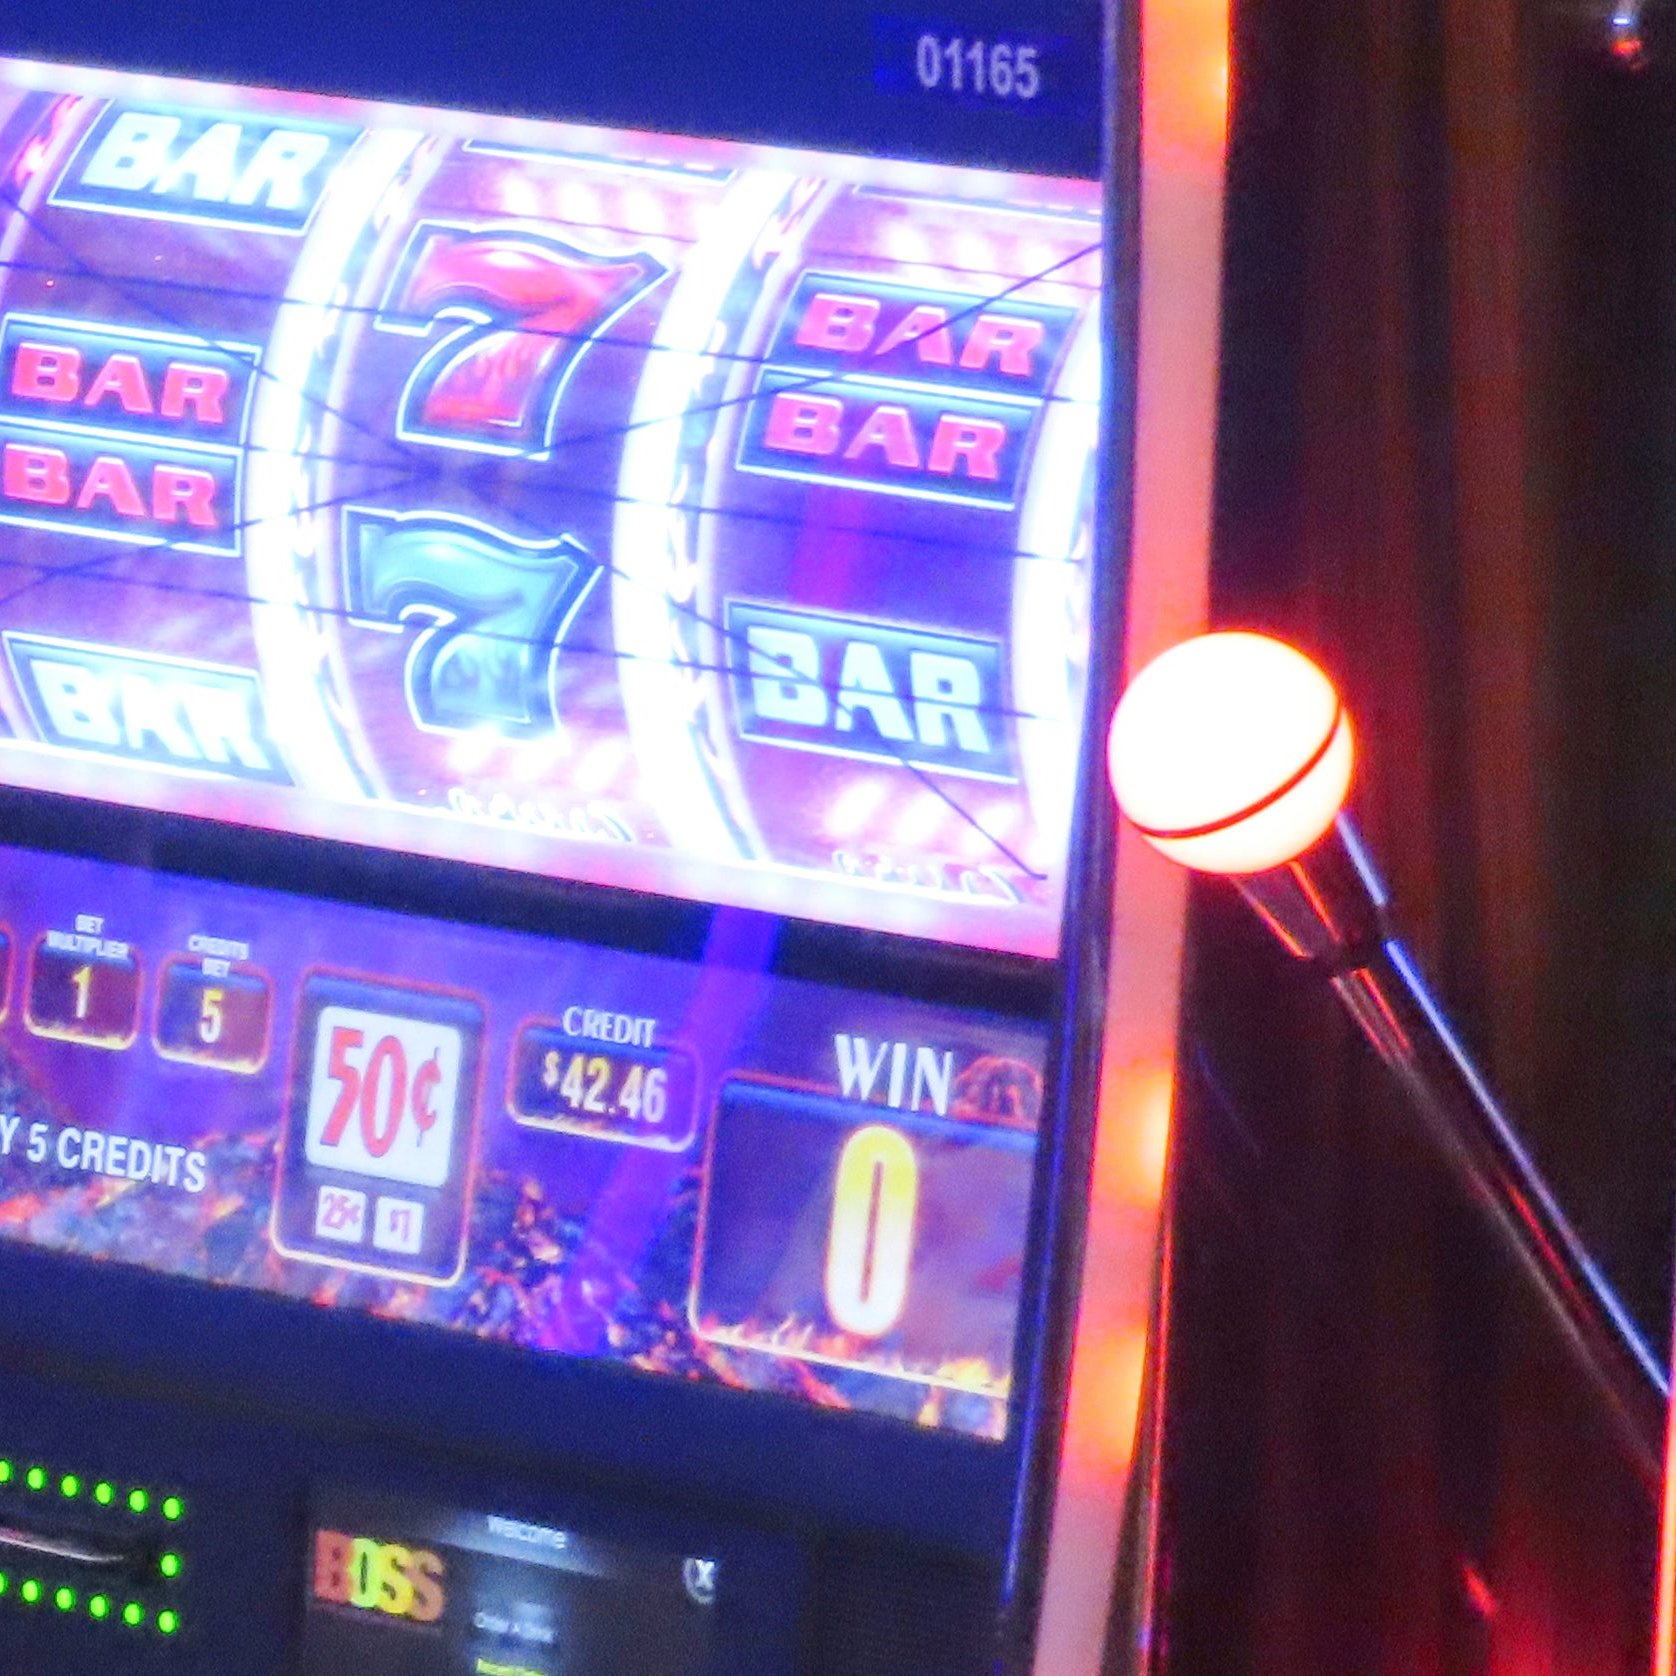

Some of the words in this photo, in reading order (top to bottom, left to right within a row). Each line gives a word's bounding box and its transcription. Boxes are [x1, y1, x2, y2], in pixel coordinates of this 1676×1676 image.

[916, 35, 1040, 98] 01165
[79, 111, 330, 210] BAR
[794, 293, 1045, 378] BAR
[11, 342, 228, 425] BAR
[764, 391, 1007, 481] BAR
[3, 443, 218, 529] BAR
[748, 626, 991, 753] BAR
[71, 965, 93, 1019] 1
[200, 987, 224, 1044] 5
[562, 1006, 657, 1048] CREDIT
[320, 1025, 442, 1158] 50¢
[543, 1050, 669, 1124] $42.46
[833, 1032, 955, 1117] WIN
[26, 1123, 49, 1165] 5
[55, 1126, 209, 1194] CREDITS
[825, 1124, 918, 1338] 0
[313, 1529, 445, 1623] BOSS
